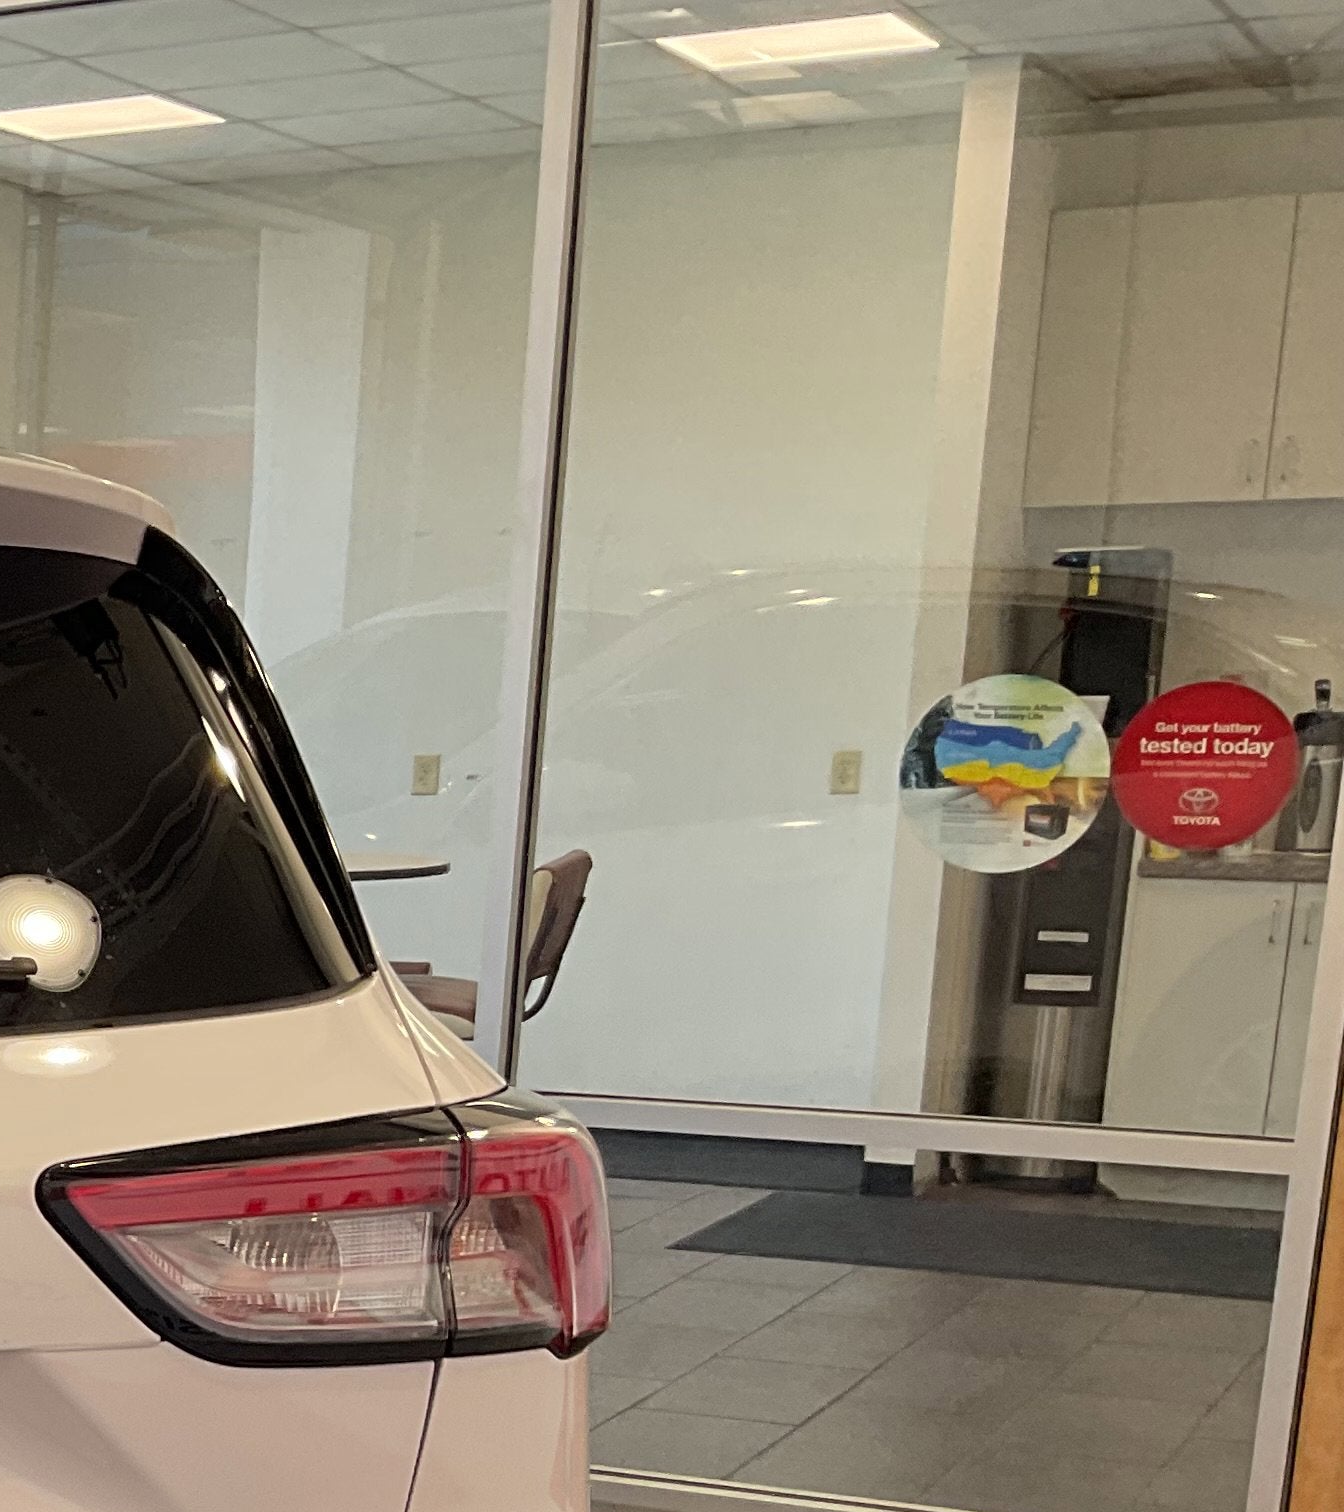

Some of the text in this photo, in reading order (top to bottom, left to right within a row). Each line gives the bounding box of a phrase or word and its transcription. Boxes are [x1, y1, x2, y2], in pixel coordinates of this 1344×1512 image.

[1155, 722, 1262, 735] Get your battery
[1140, 737, 1274, 758] tested today
[1172, 815, 1221, 826] TOYOTA
